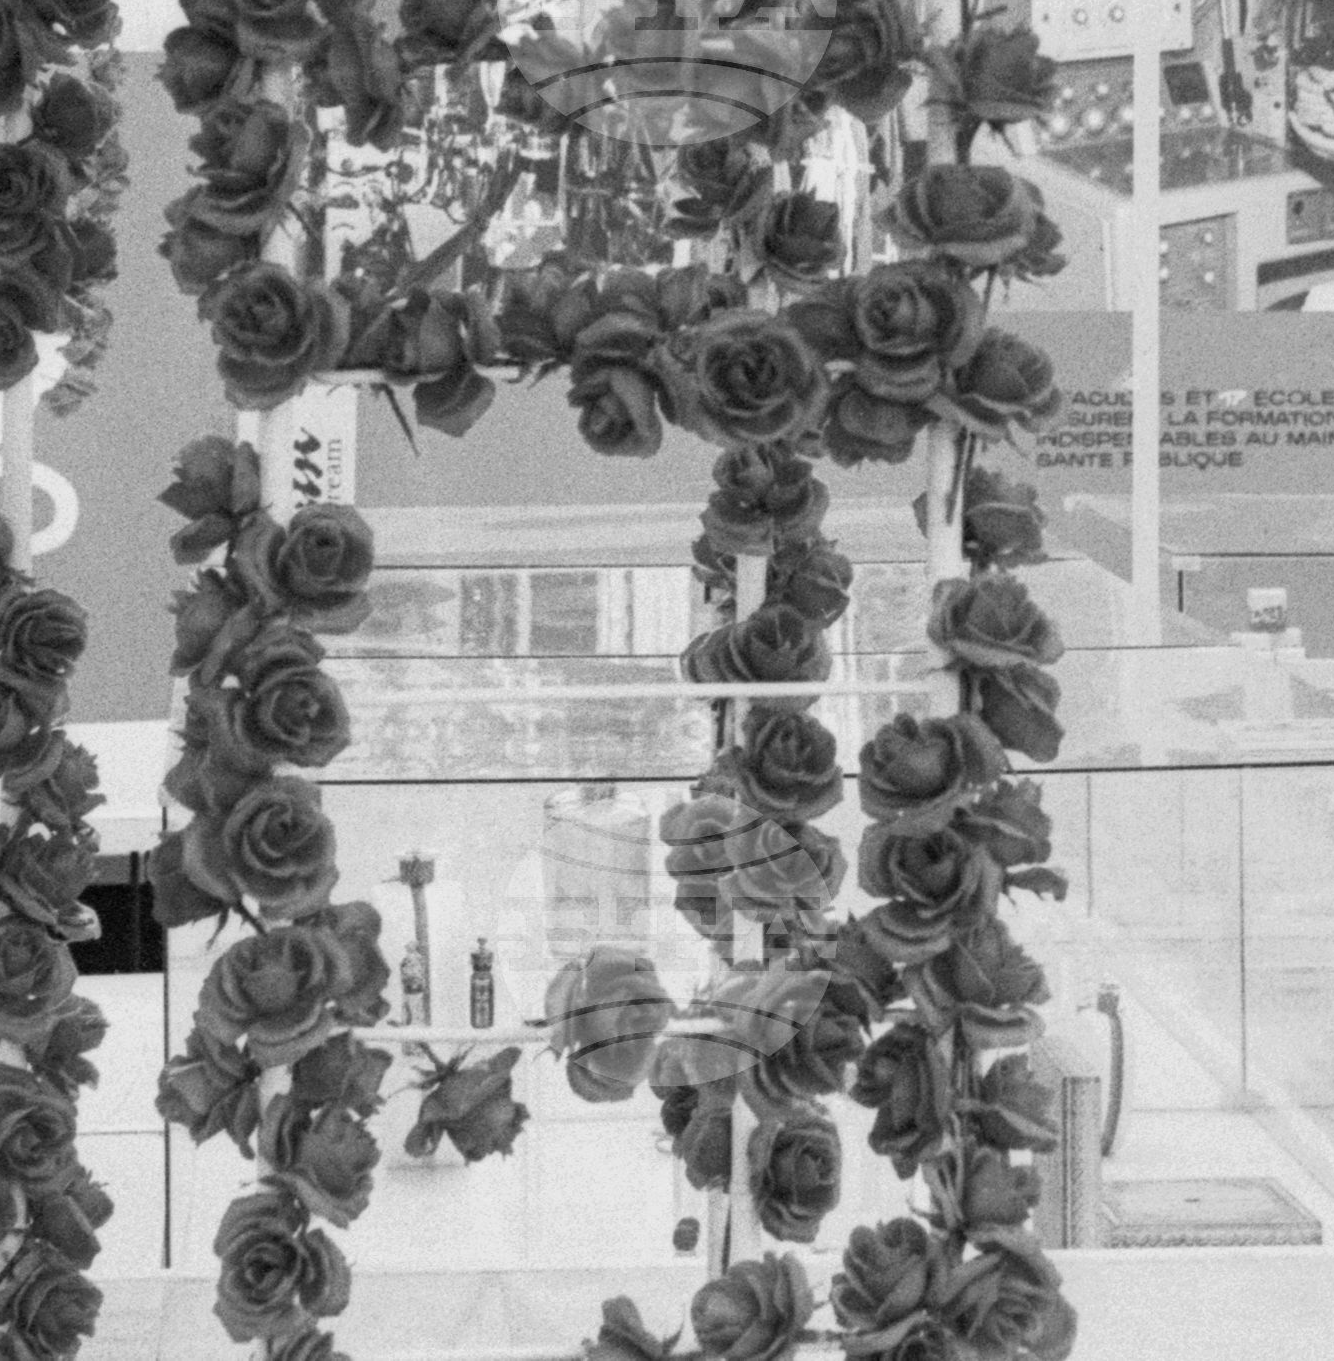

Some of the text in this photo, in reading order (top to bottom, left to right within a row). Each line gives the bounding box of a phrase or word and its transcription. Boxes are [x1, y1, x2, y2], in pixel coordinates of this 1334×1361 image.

[1067, 390, 1175, 406] ACULS
[1185, 390, 1213, 406] ET
[1167, 411, 1198, 426] LA
[1035, 431, 1237, 448] INDISPEABLES
[1245, 431, 1279, 446] AU
[326, 438, 342, 501] ream
[1036, 451, 1244, 471] SANTE PBLIQUE
